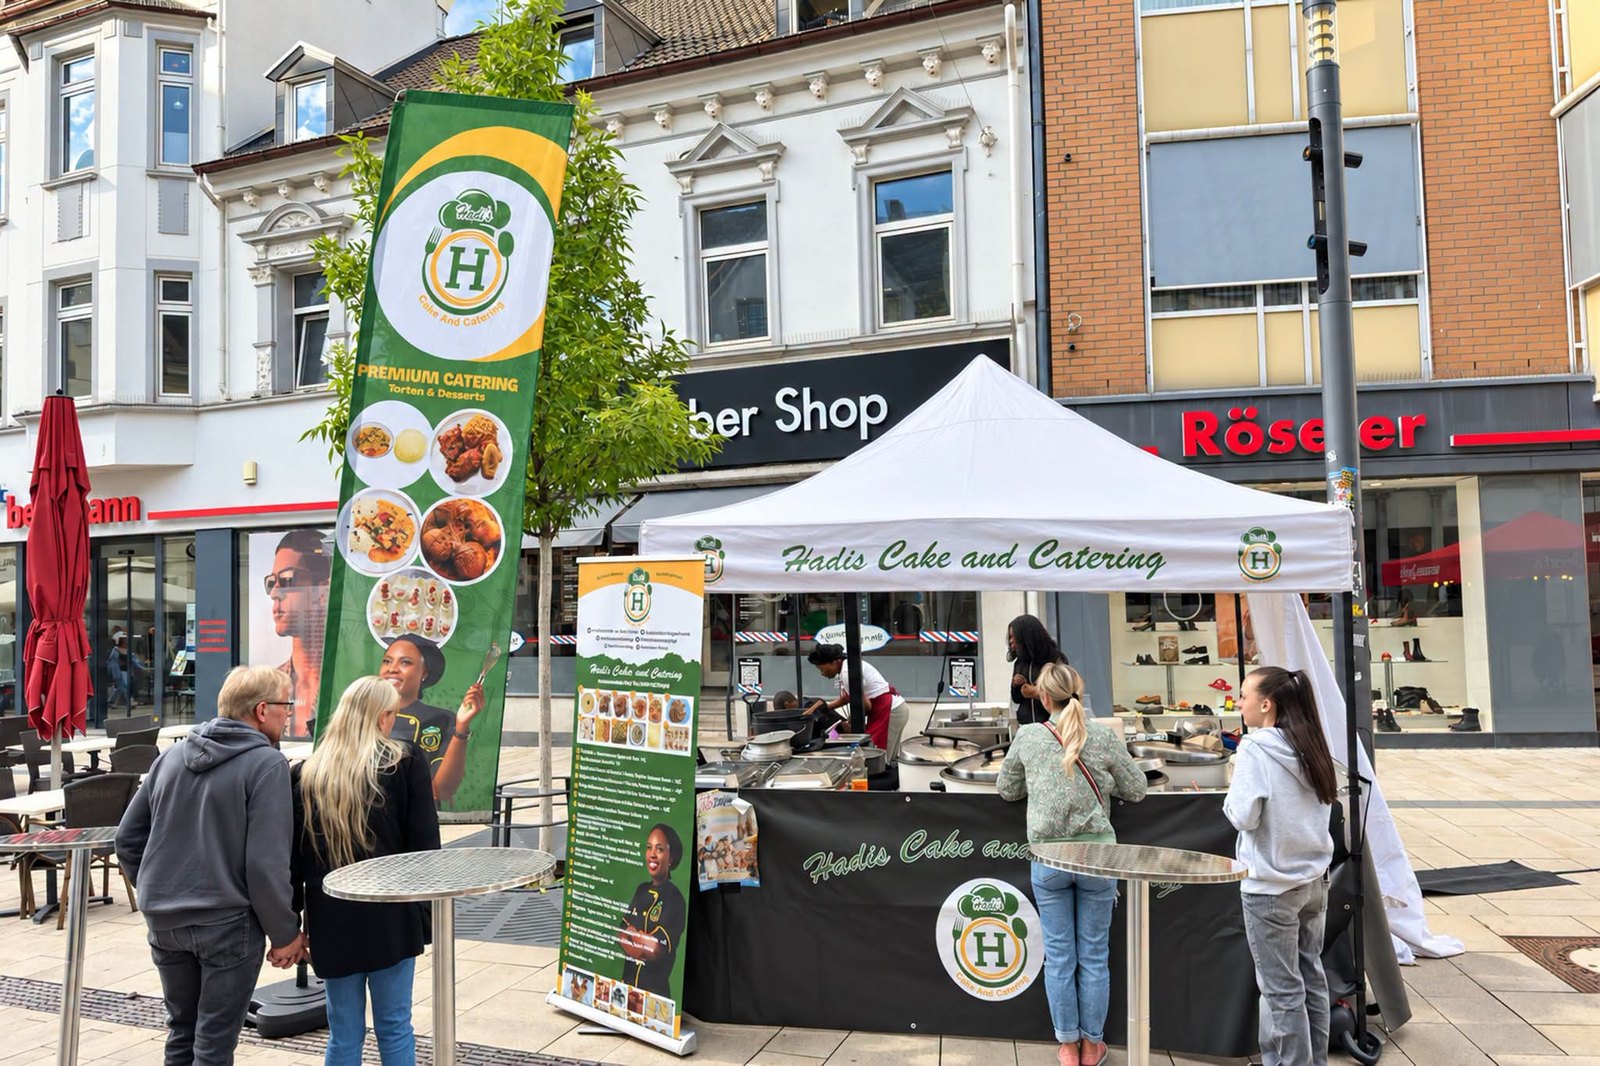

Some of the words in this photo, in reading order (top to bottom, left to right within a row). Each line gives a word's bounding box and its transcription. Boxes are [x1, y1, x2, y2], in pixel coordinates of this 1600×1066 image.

[445, 246, 489, 291] H
[419, 294, 439, 317] Cake
[440, 314, 460, 326] And
[463, 301, 506, 327] Catering
[357, 364, 439, 385] PREMIUM
[443, 372, 519, 392] CATERING
[389, 384, 424, 396] Torten
[427, 388, 435, 396] &
[438, 388, 486, 401] Desserts
[688, 397, 760, 441] ber
[775, 387, 889, 440] Shop
[1181, 406, 1427, 457] Röseer
[6, 495, 141, 529] beann
[781, 544, 868, 573] Hadis
[877, 539, 952, 572] Cake
[961, 543, 1018, 570] and
[1028, 539, 1167, 580] Catering
[1250, 551, 1271, 570] H
[631, 592, 644, 611] H
[803, 843, 891, 884] Hadis
[900, 829, 975, 864] Cake
[973, 931, 1009, 967] H
[955, 971, 975, 991] Cake
[976, 987, 994, 997] And
[995, 975, 1031, 997] Catering
